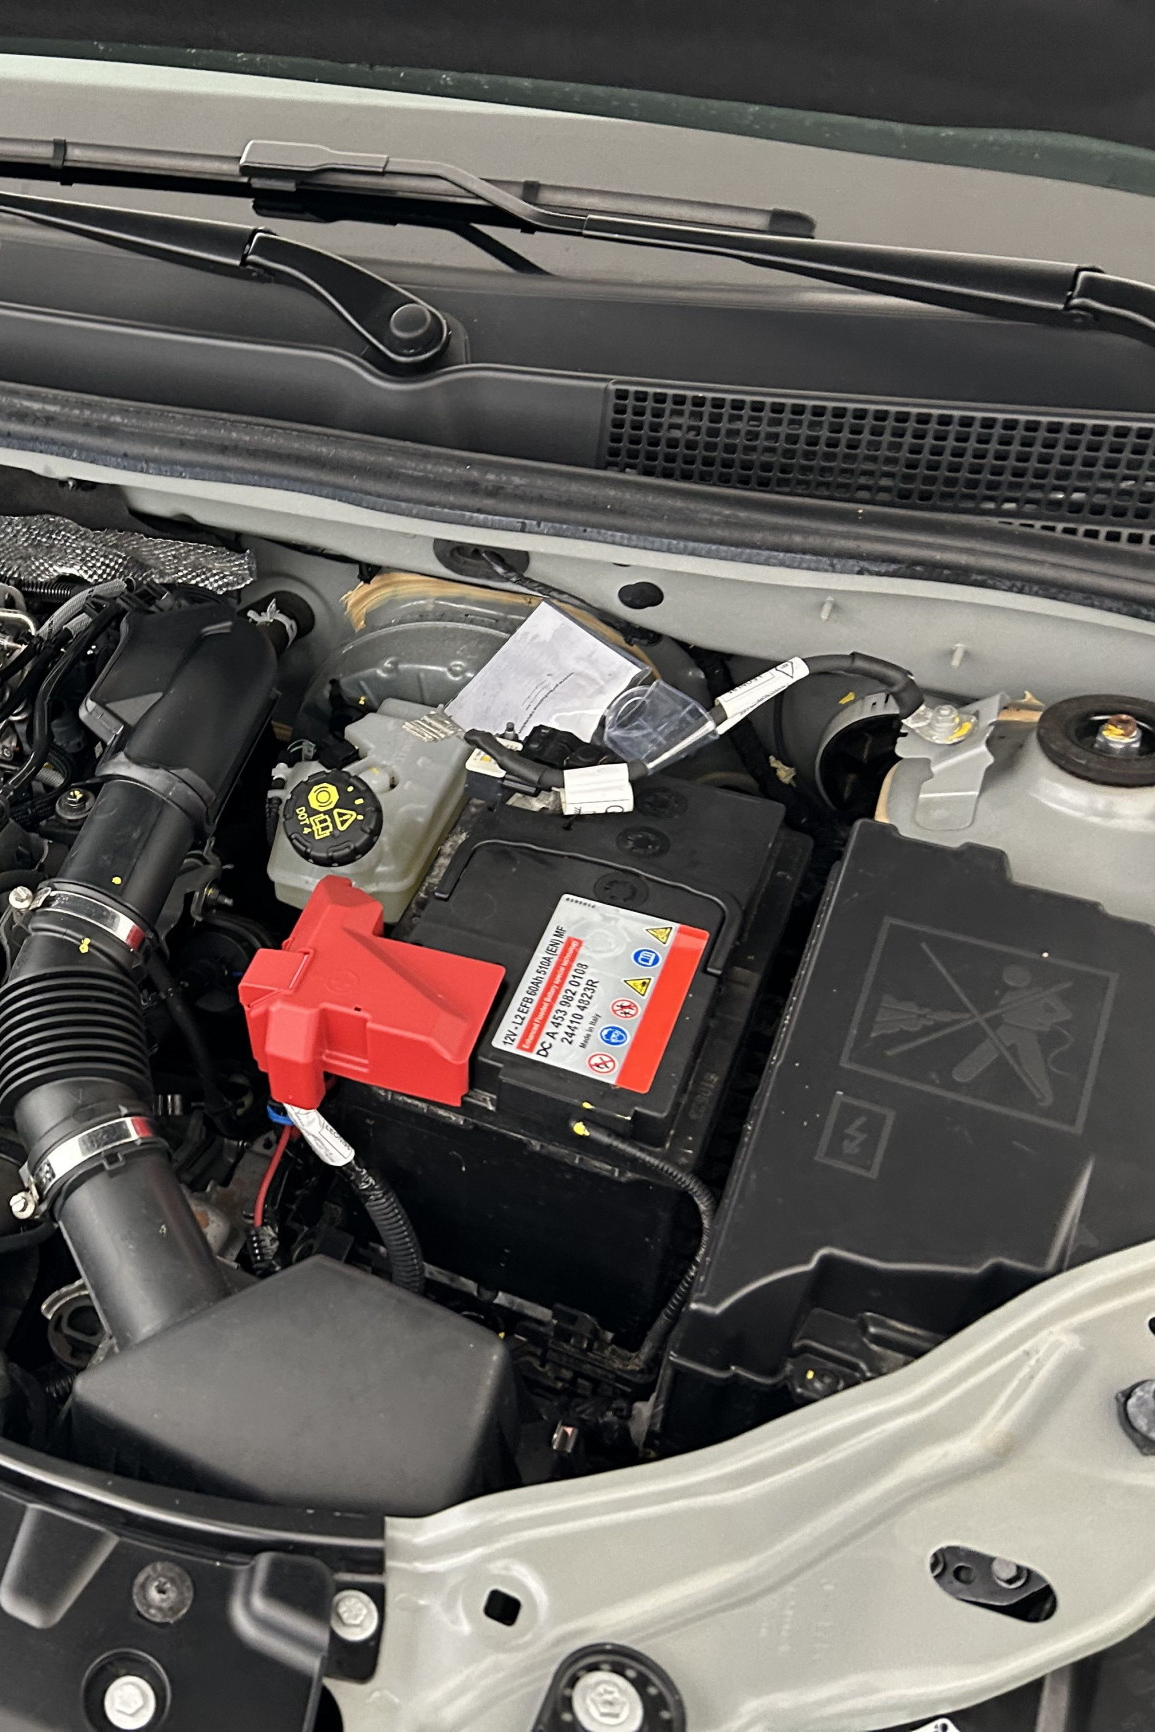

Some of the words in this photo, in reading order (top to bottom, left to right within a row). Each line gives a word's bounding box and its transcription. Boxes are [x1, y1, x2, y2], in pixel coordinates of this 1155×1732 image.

[295, 806, 309, 825] DOT
[553, 926, 566, 938] MF
[544, 936, 562, 955] (EN)
[560, 939, 580, 966] technology
[536, 954, 553, 974] 510A
[568, 961, 589, 986] 0108
[551, 966, 567, 984] special
[526, 974, 544, 996] 60Ah
[544, 984, 559, 1002] Battery
[517, 996, 534, 1013] EFB
[558, 987, 577, 1006] 982
[512, 1013, 526, 1025] L2
[534, 1002, 548, 1022] Flooded
[549, 1008, 567, 1027] 453
[560, 1012, 584, 1045] 24410
[575, 978, 600, 1011] 4823R
[502, 1030, 518, 1046] 12V
[520, 1022, 539, 1048] Enhanced
[544, 1026, 559, 1038] A
[578, 1032, 592, 1048] Made
[588, 1012, 601, 1026] Italy
[535, 1040, 553, 1057] DC
